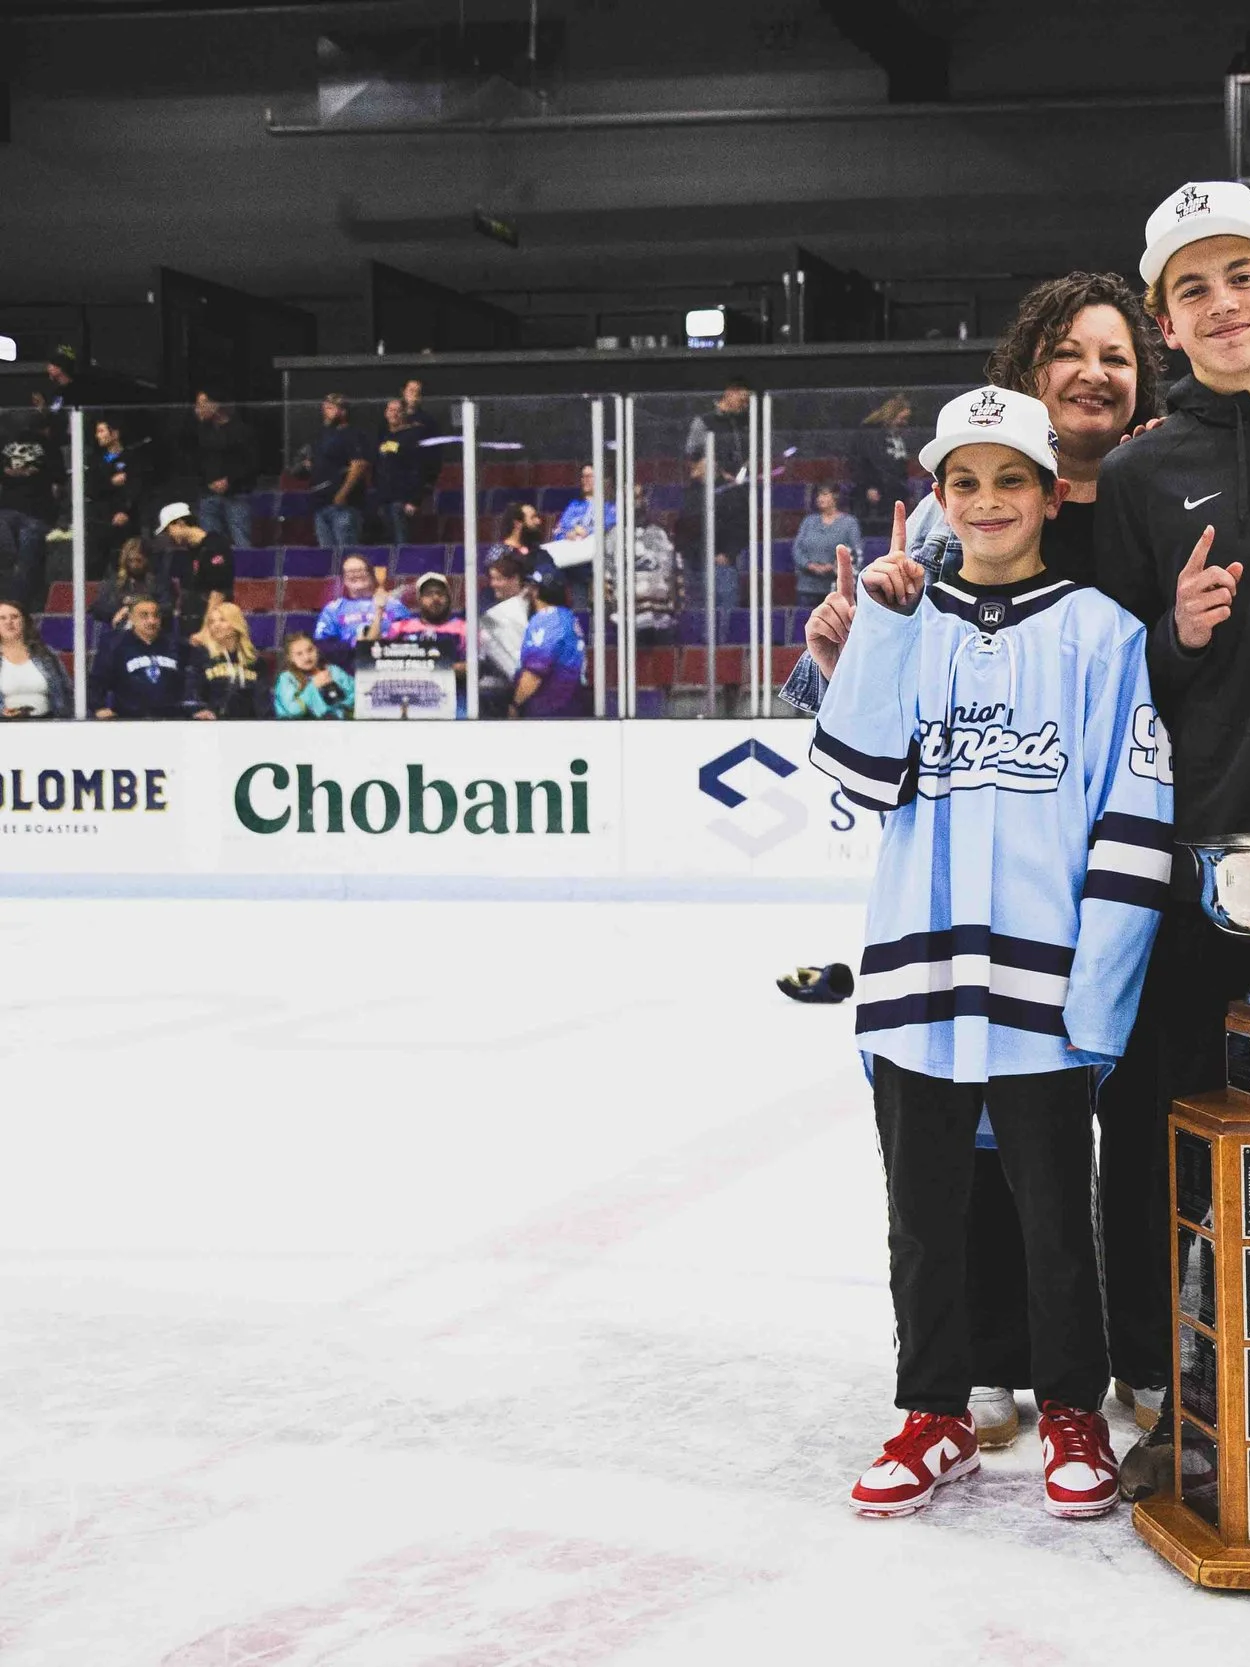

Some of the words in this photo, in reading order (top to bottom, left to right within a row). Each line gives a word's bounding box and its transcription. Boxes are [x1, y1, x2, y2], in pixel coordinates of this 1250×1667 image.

[0, 769, 168, 813] LOMBE
[234, 758, 590, 835] Chobani
[25, 824, 99, 834] ROASTERS
